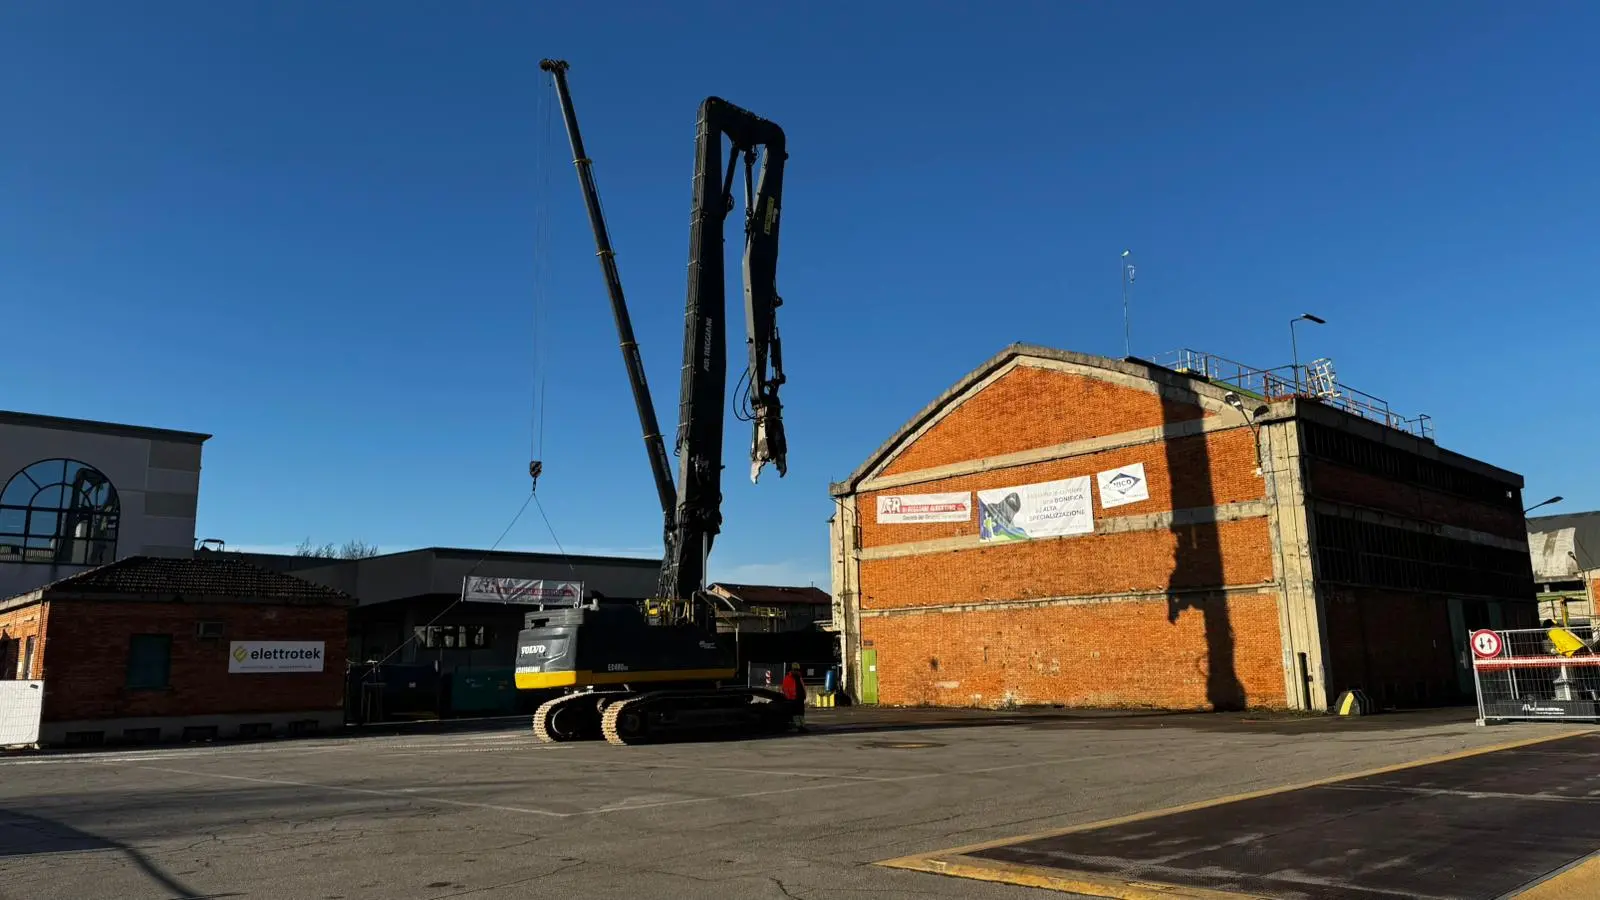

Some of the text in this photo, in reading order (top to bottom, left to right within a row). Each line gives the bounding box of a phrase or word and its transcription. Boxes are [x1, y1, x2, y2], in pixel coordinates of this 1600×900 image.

[1054, 494, 1084, 504] BONIFICA
[251, 647, 321, 660] elettrotek
[521, 645, 546, 654] VOLVO
